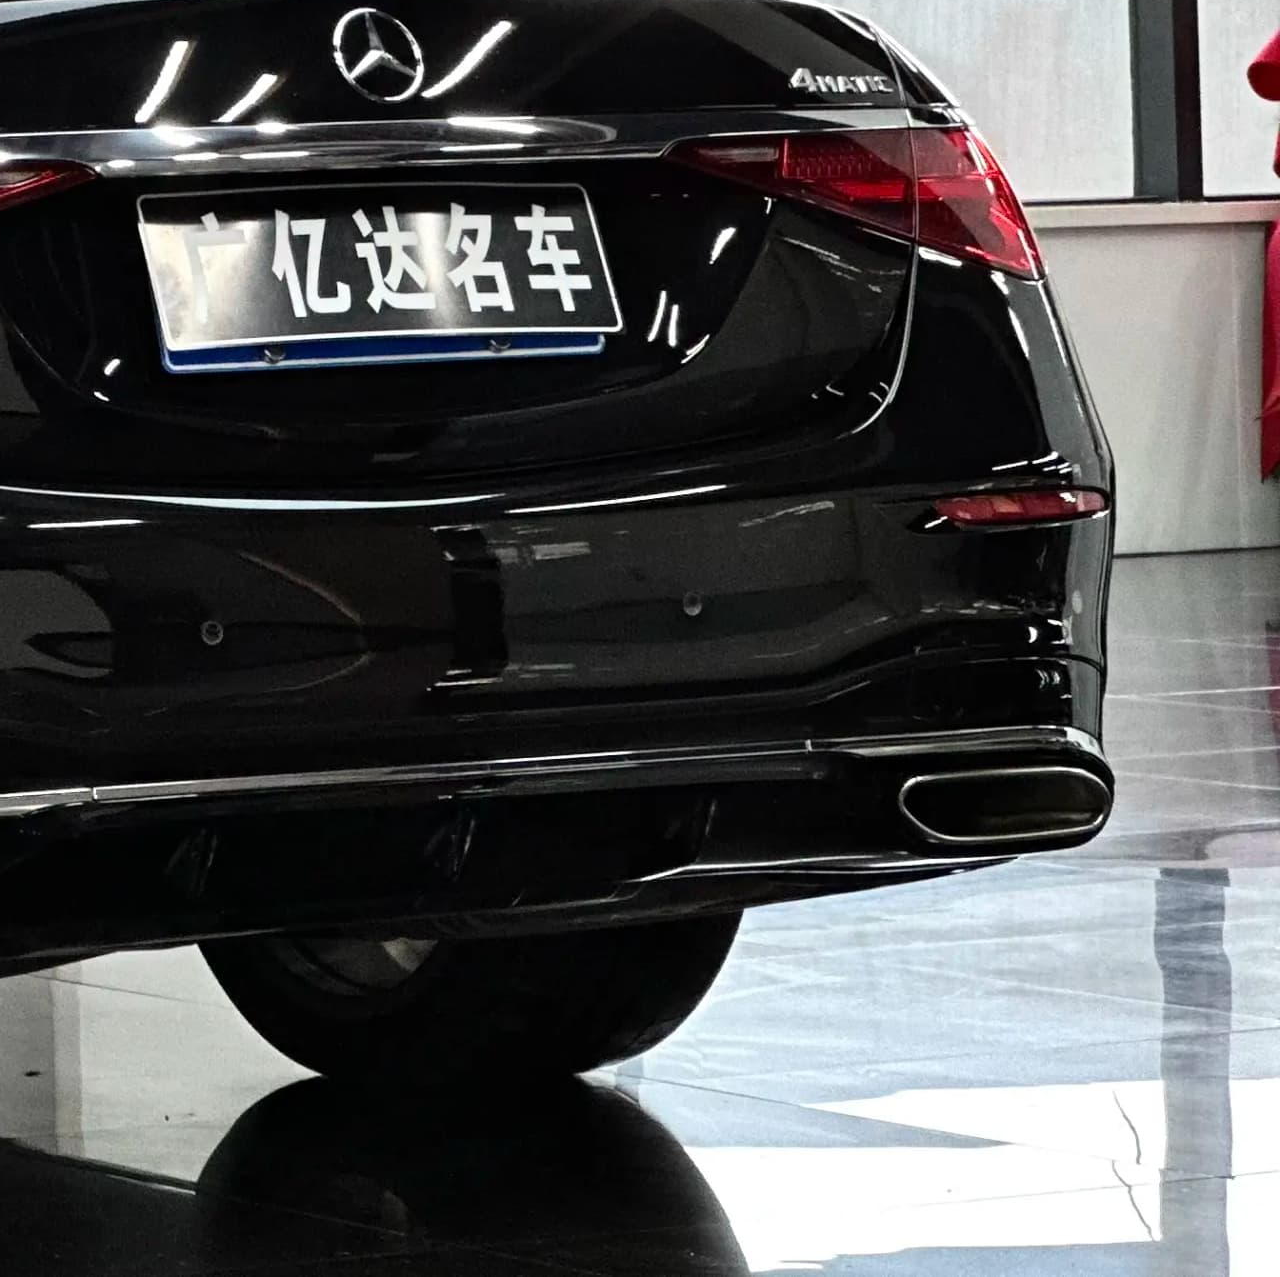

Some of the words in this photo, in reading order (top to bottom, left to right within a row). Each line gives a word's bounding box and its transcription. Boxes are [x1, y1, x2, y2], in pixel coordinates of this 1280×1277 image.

[184, 201, 593, 323] 广亿达名车
